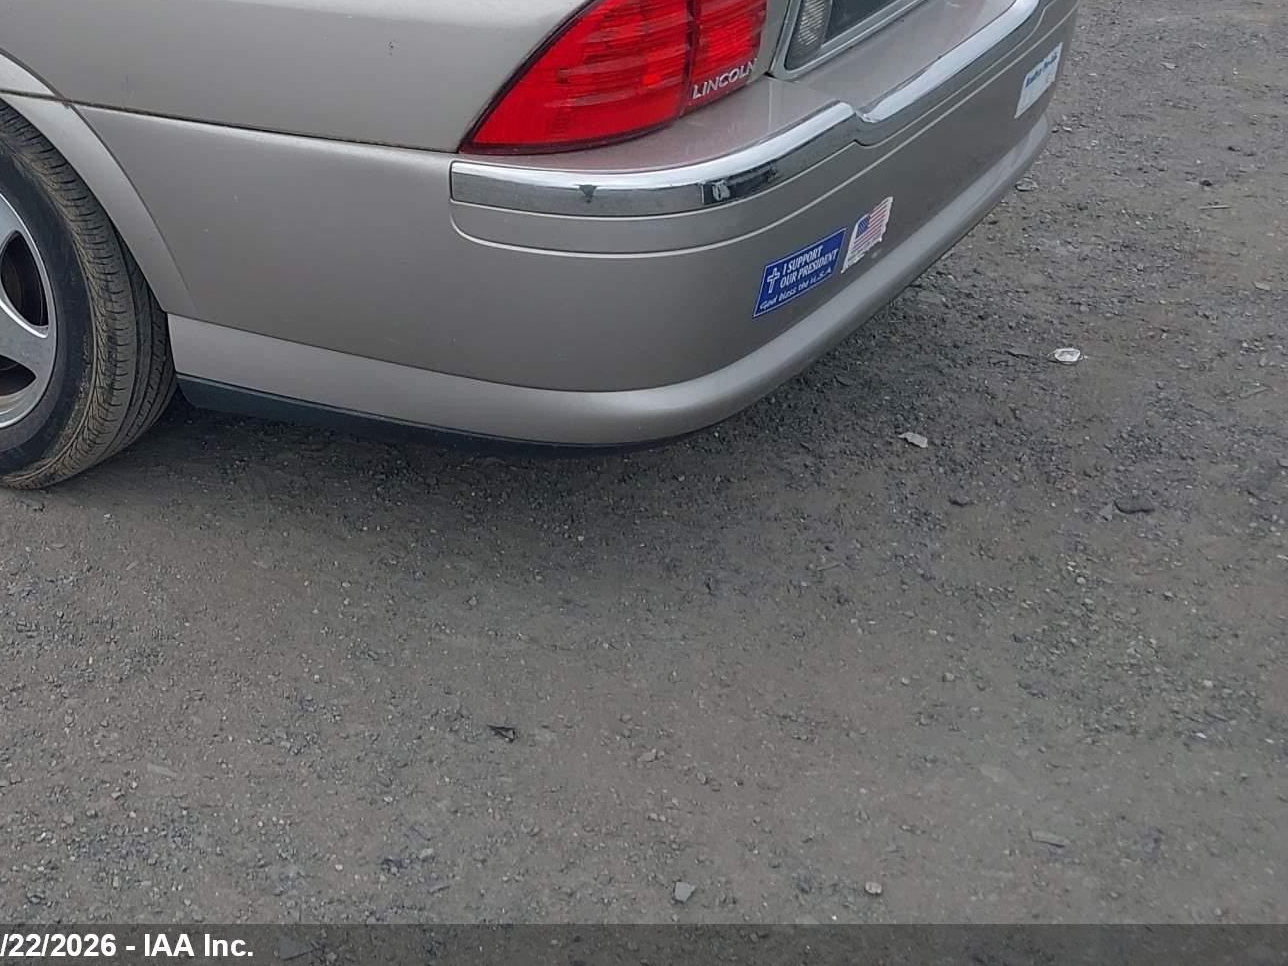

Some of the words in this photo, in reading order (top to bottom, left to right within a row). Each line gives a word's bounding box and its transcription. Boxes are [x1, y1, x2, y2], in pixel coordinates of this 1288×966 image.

[692, 58, 758, 99] LINCOLN
[780, 271, 798, 288] OUR
[797, 248, 839, 280] PRESIDENT
[787, 245, 824, 273] SUPPORT
[759, 295, 778, 310] God
